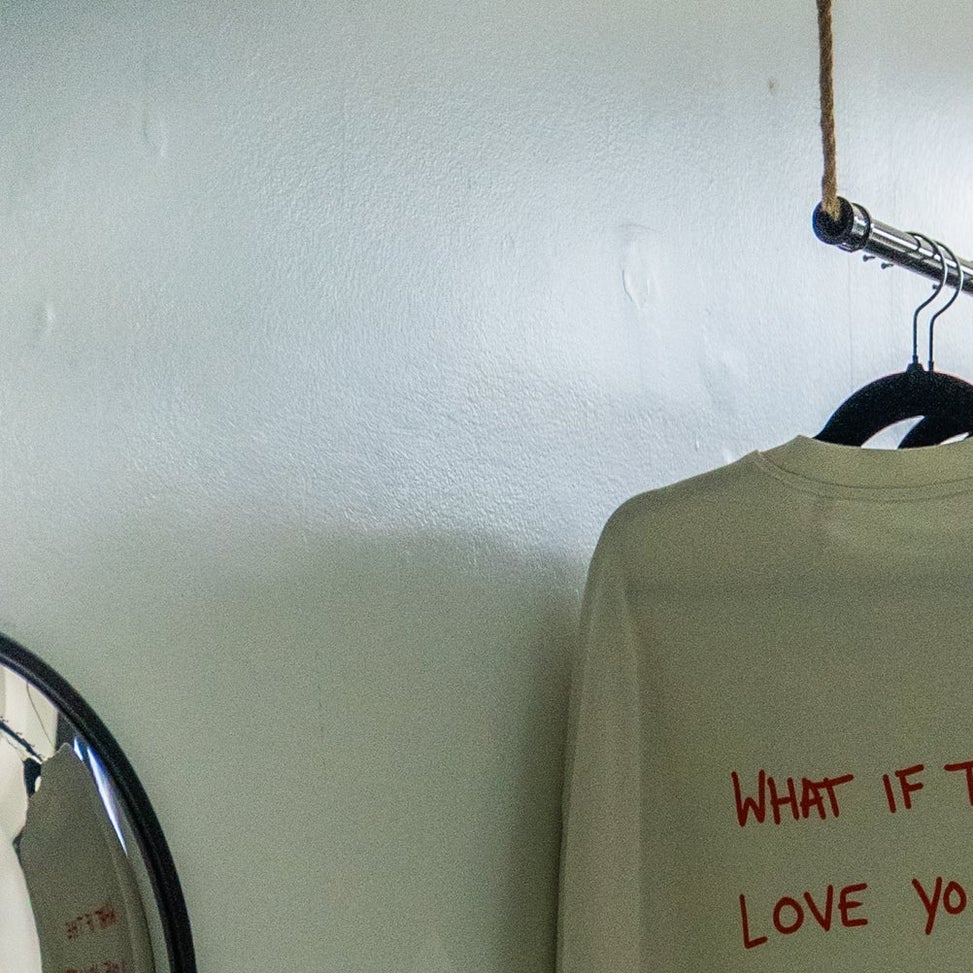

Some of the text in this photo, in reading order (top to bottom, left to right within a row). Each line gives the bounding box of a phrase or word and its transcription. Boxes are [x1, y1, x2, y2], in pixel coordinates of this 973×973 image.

[731, 770, 853, 827] WHAT
[883, 764, 924, 813] IF
[739, 883, 868, 949] LOVE
